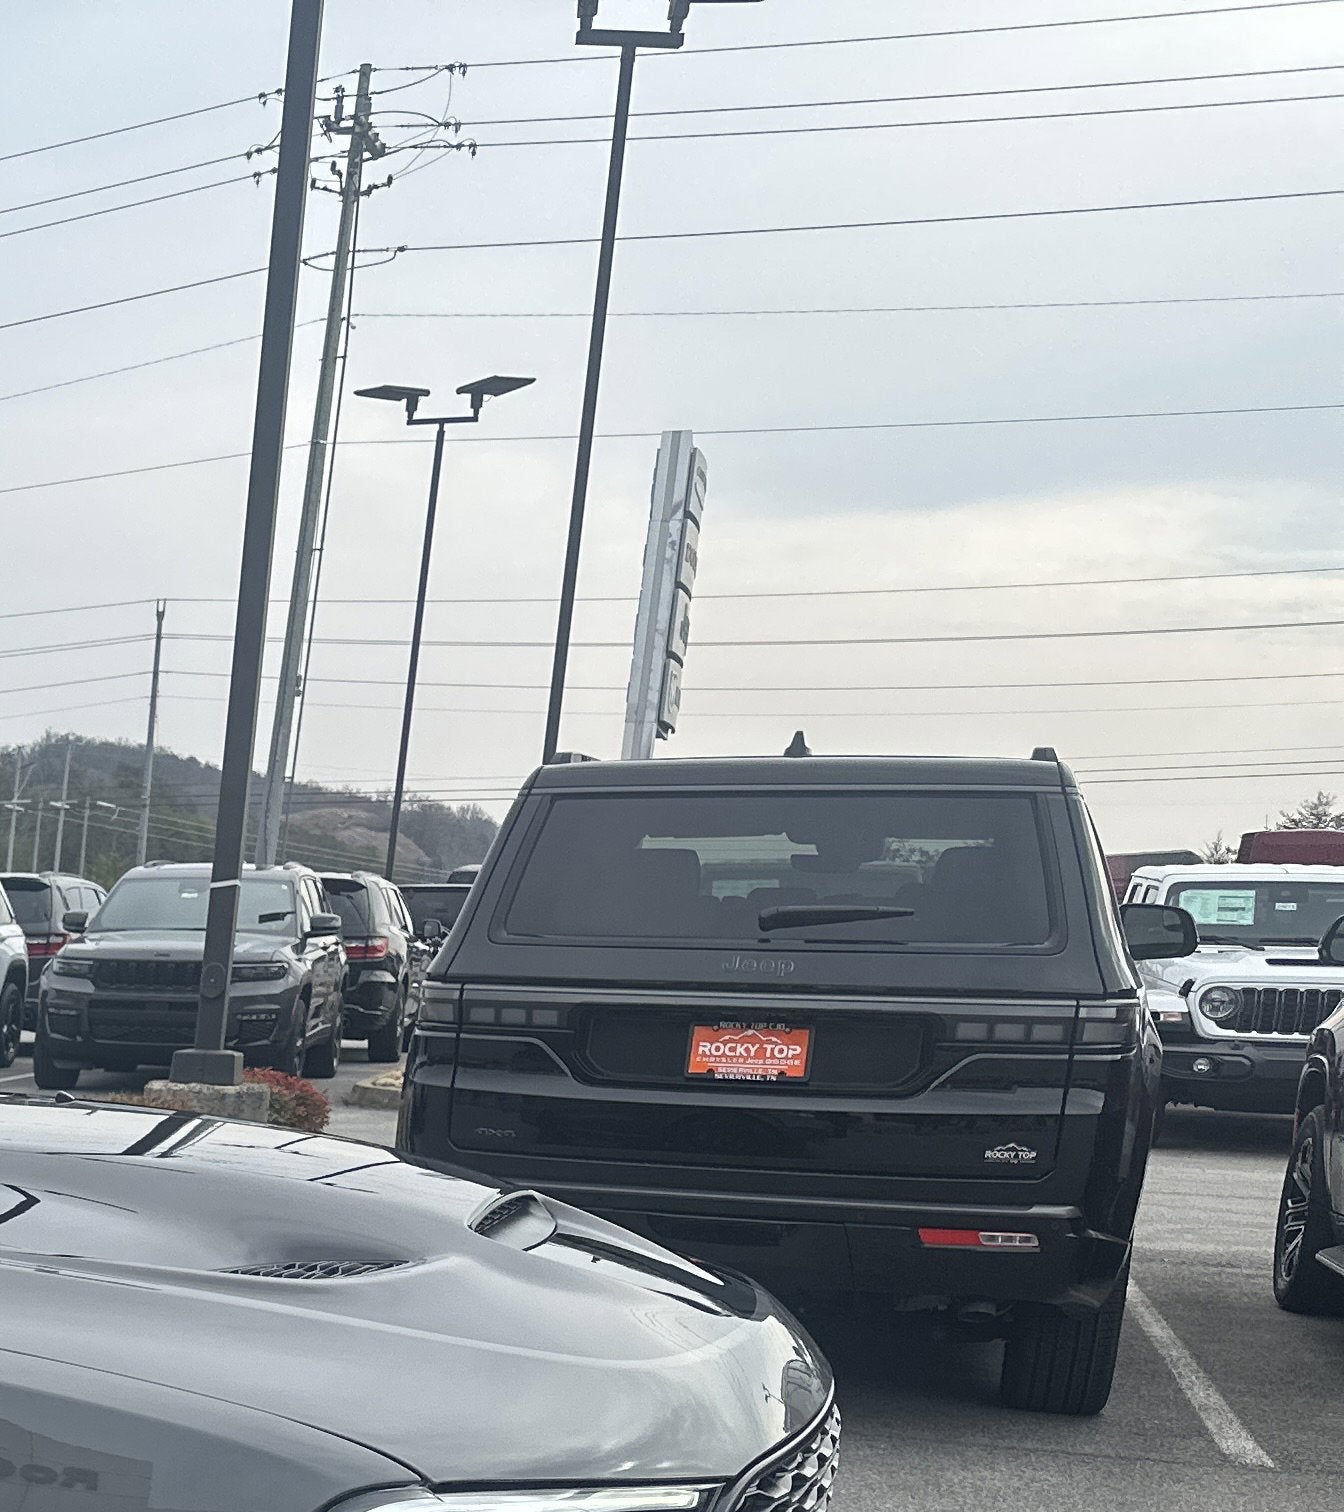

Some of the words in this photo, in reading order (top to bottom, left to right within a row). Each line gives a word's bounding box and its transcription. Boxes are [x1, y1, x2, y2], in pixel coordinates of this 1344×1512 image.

[721, 955, 795, 976] Jeep
[698, 1041, 759, 1057] ROCKY
[763, 1043, 802, 1059] TOP
[984, 1150, 1016, 1159] ROCKY
[1018, 1151, 1037, 1159] TOP
